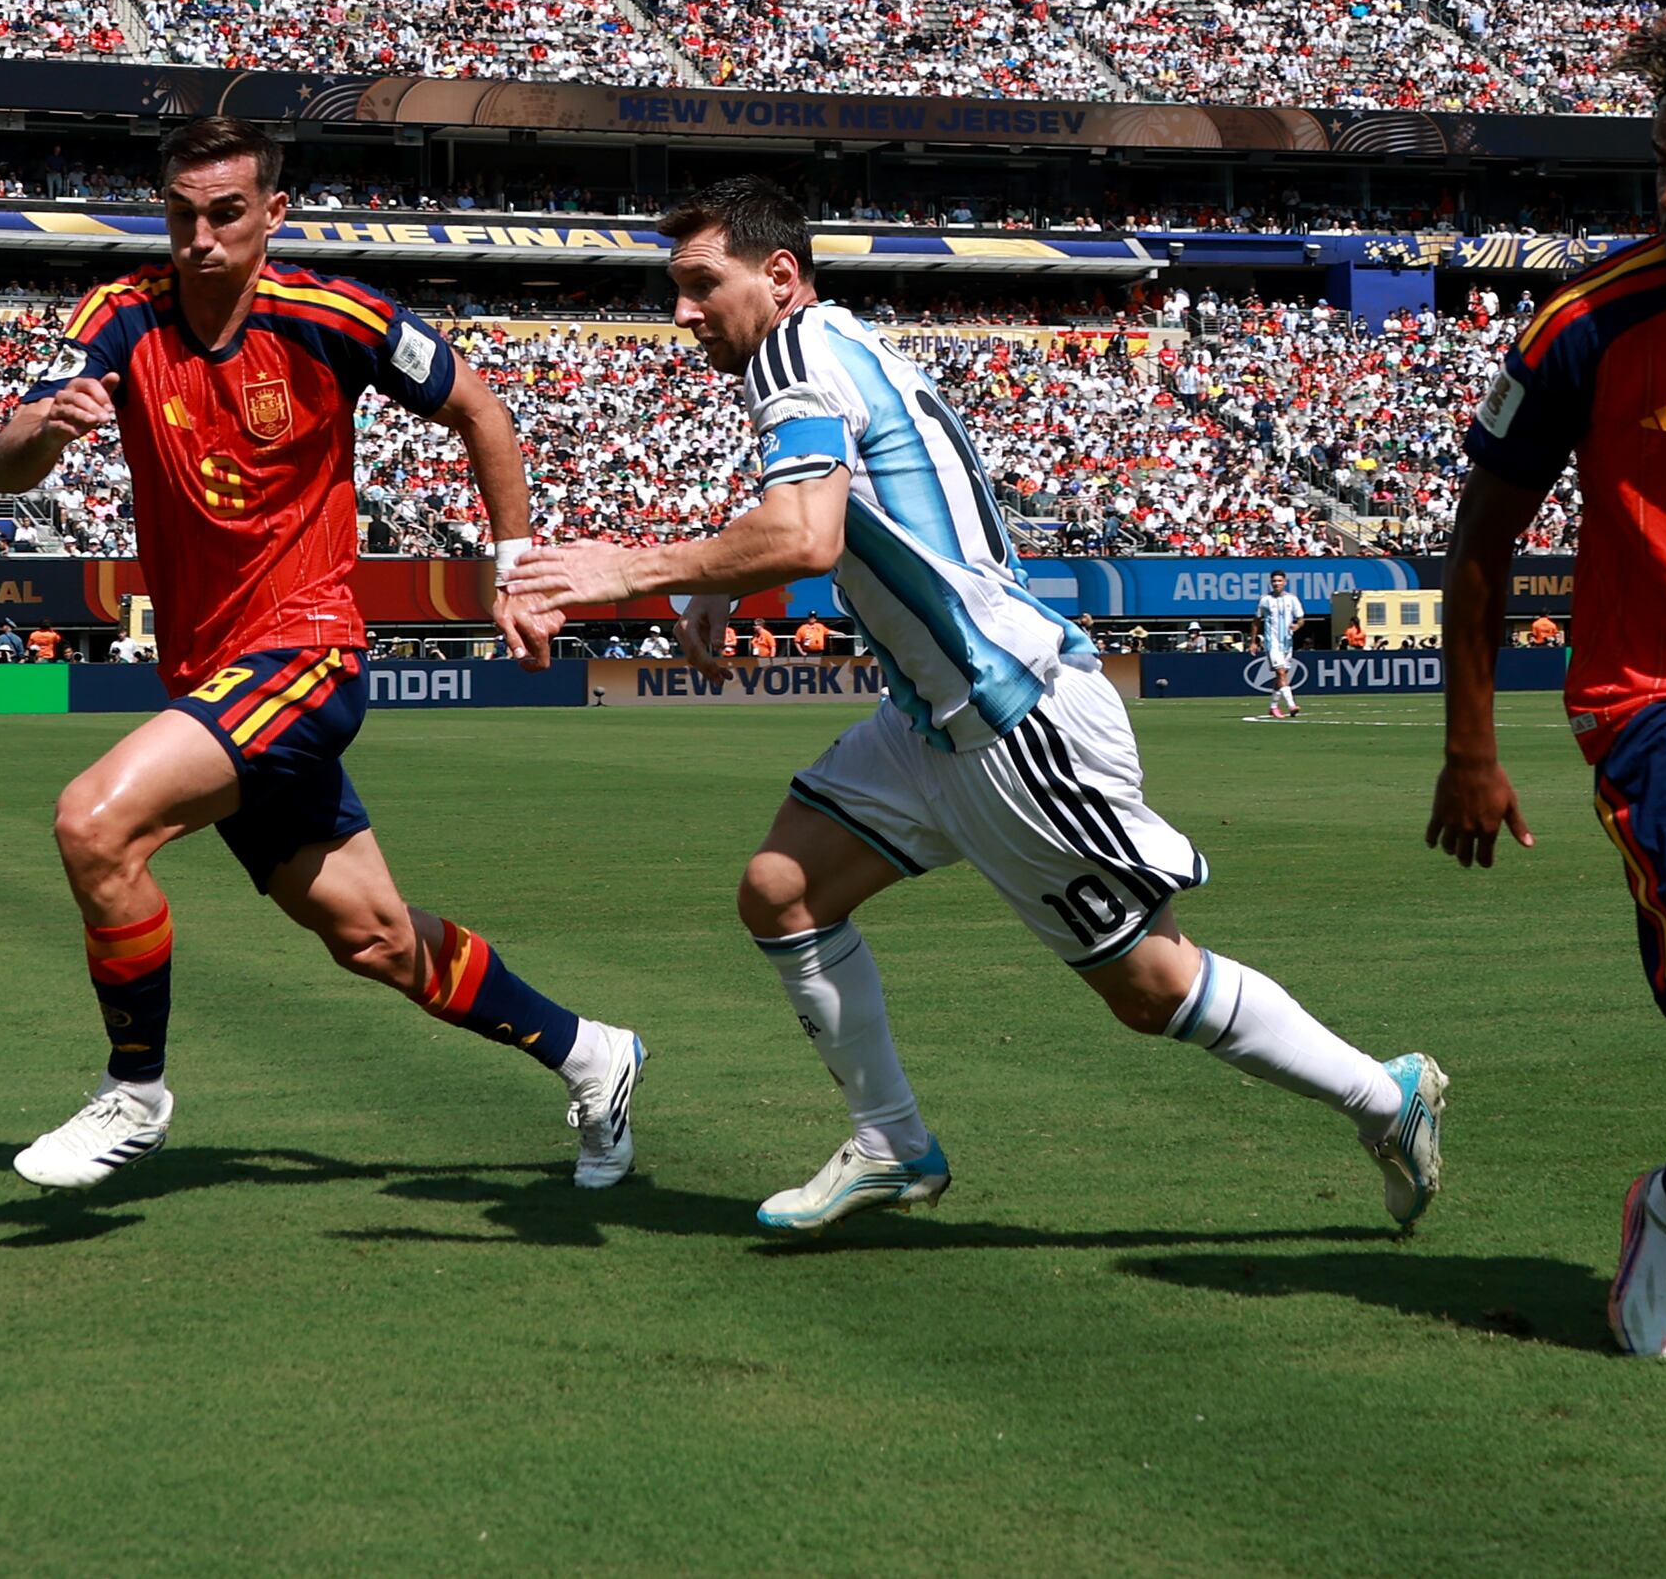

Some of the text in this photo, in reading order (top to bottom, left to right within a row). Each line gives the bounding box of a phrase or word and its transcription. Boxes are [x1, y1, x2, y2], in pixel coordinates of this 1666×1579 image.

[619, 96, 1087, 135] NEW YORK NEW JERSEY
[285, 221, 660, 250] THE FINAL
[368, 668, 472, 701] NDAI
[637, 666, 725, 697] NEW
[738, 665, 843, 696] YORK
[1317, 657, 1441, 688] HYUND
[1041, 874, 1127, 948] 10
